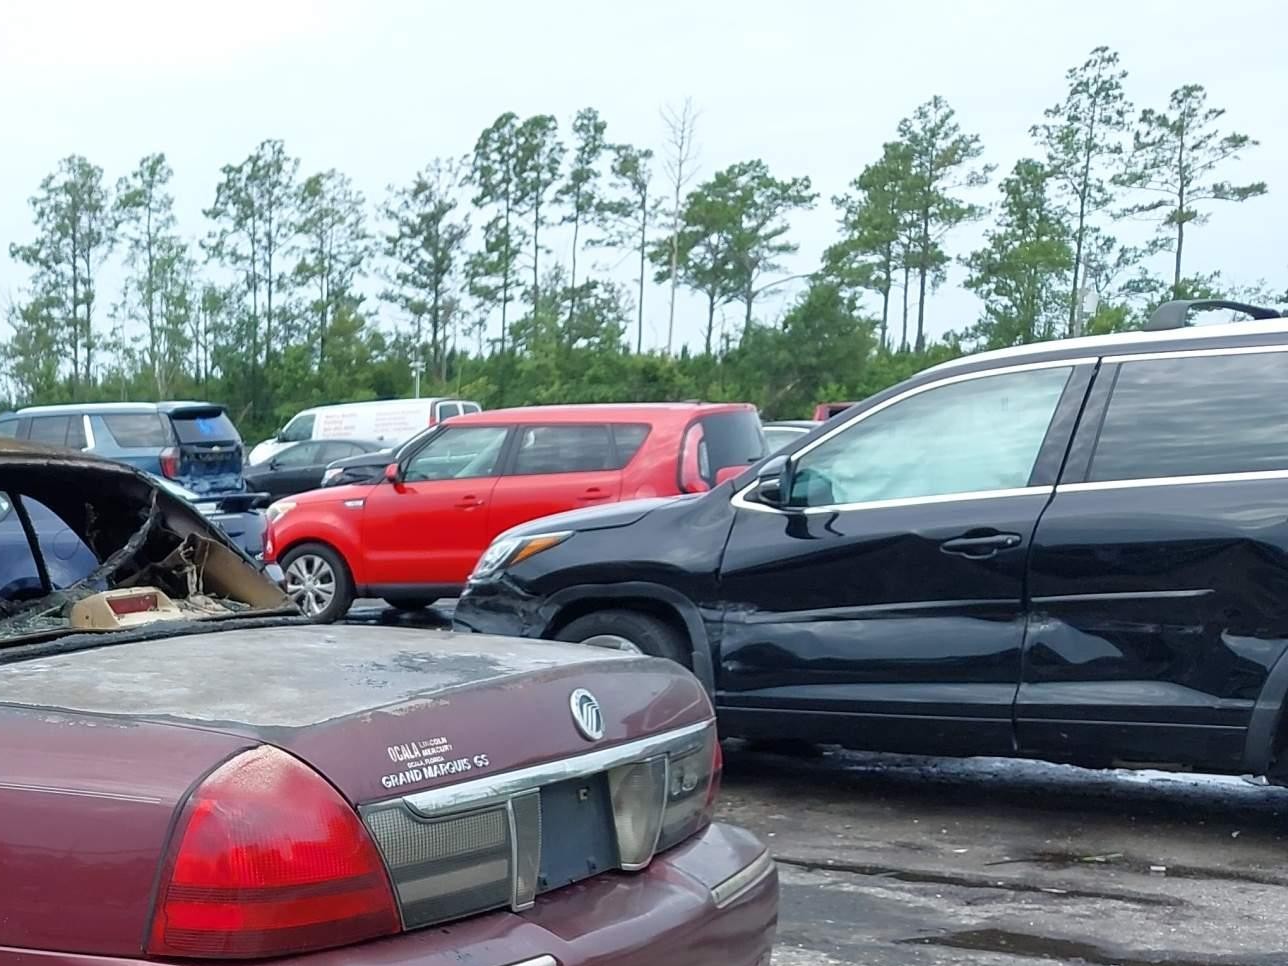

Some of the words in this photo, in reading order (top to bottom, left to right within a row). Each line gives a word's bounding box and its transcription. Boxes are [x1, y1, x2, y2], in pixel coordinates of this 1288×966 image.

[387, 742, 422, 763] OCALA
[422, 744, 453, 757] MERCURY
[381, 769, 423, 788] GRAND
[423, 758, 472, 779] MARQUIS
[473, 754, 490, 767] GS
